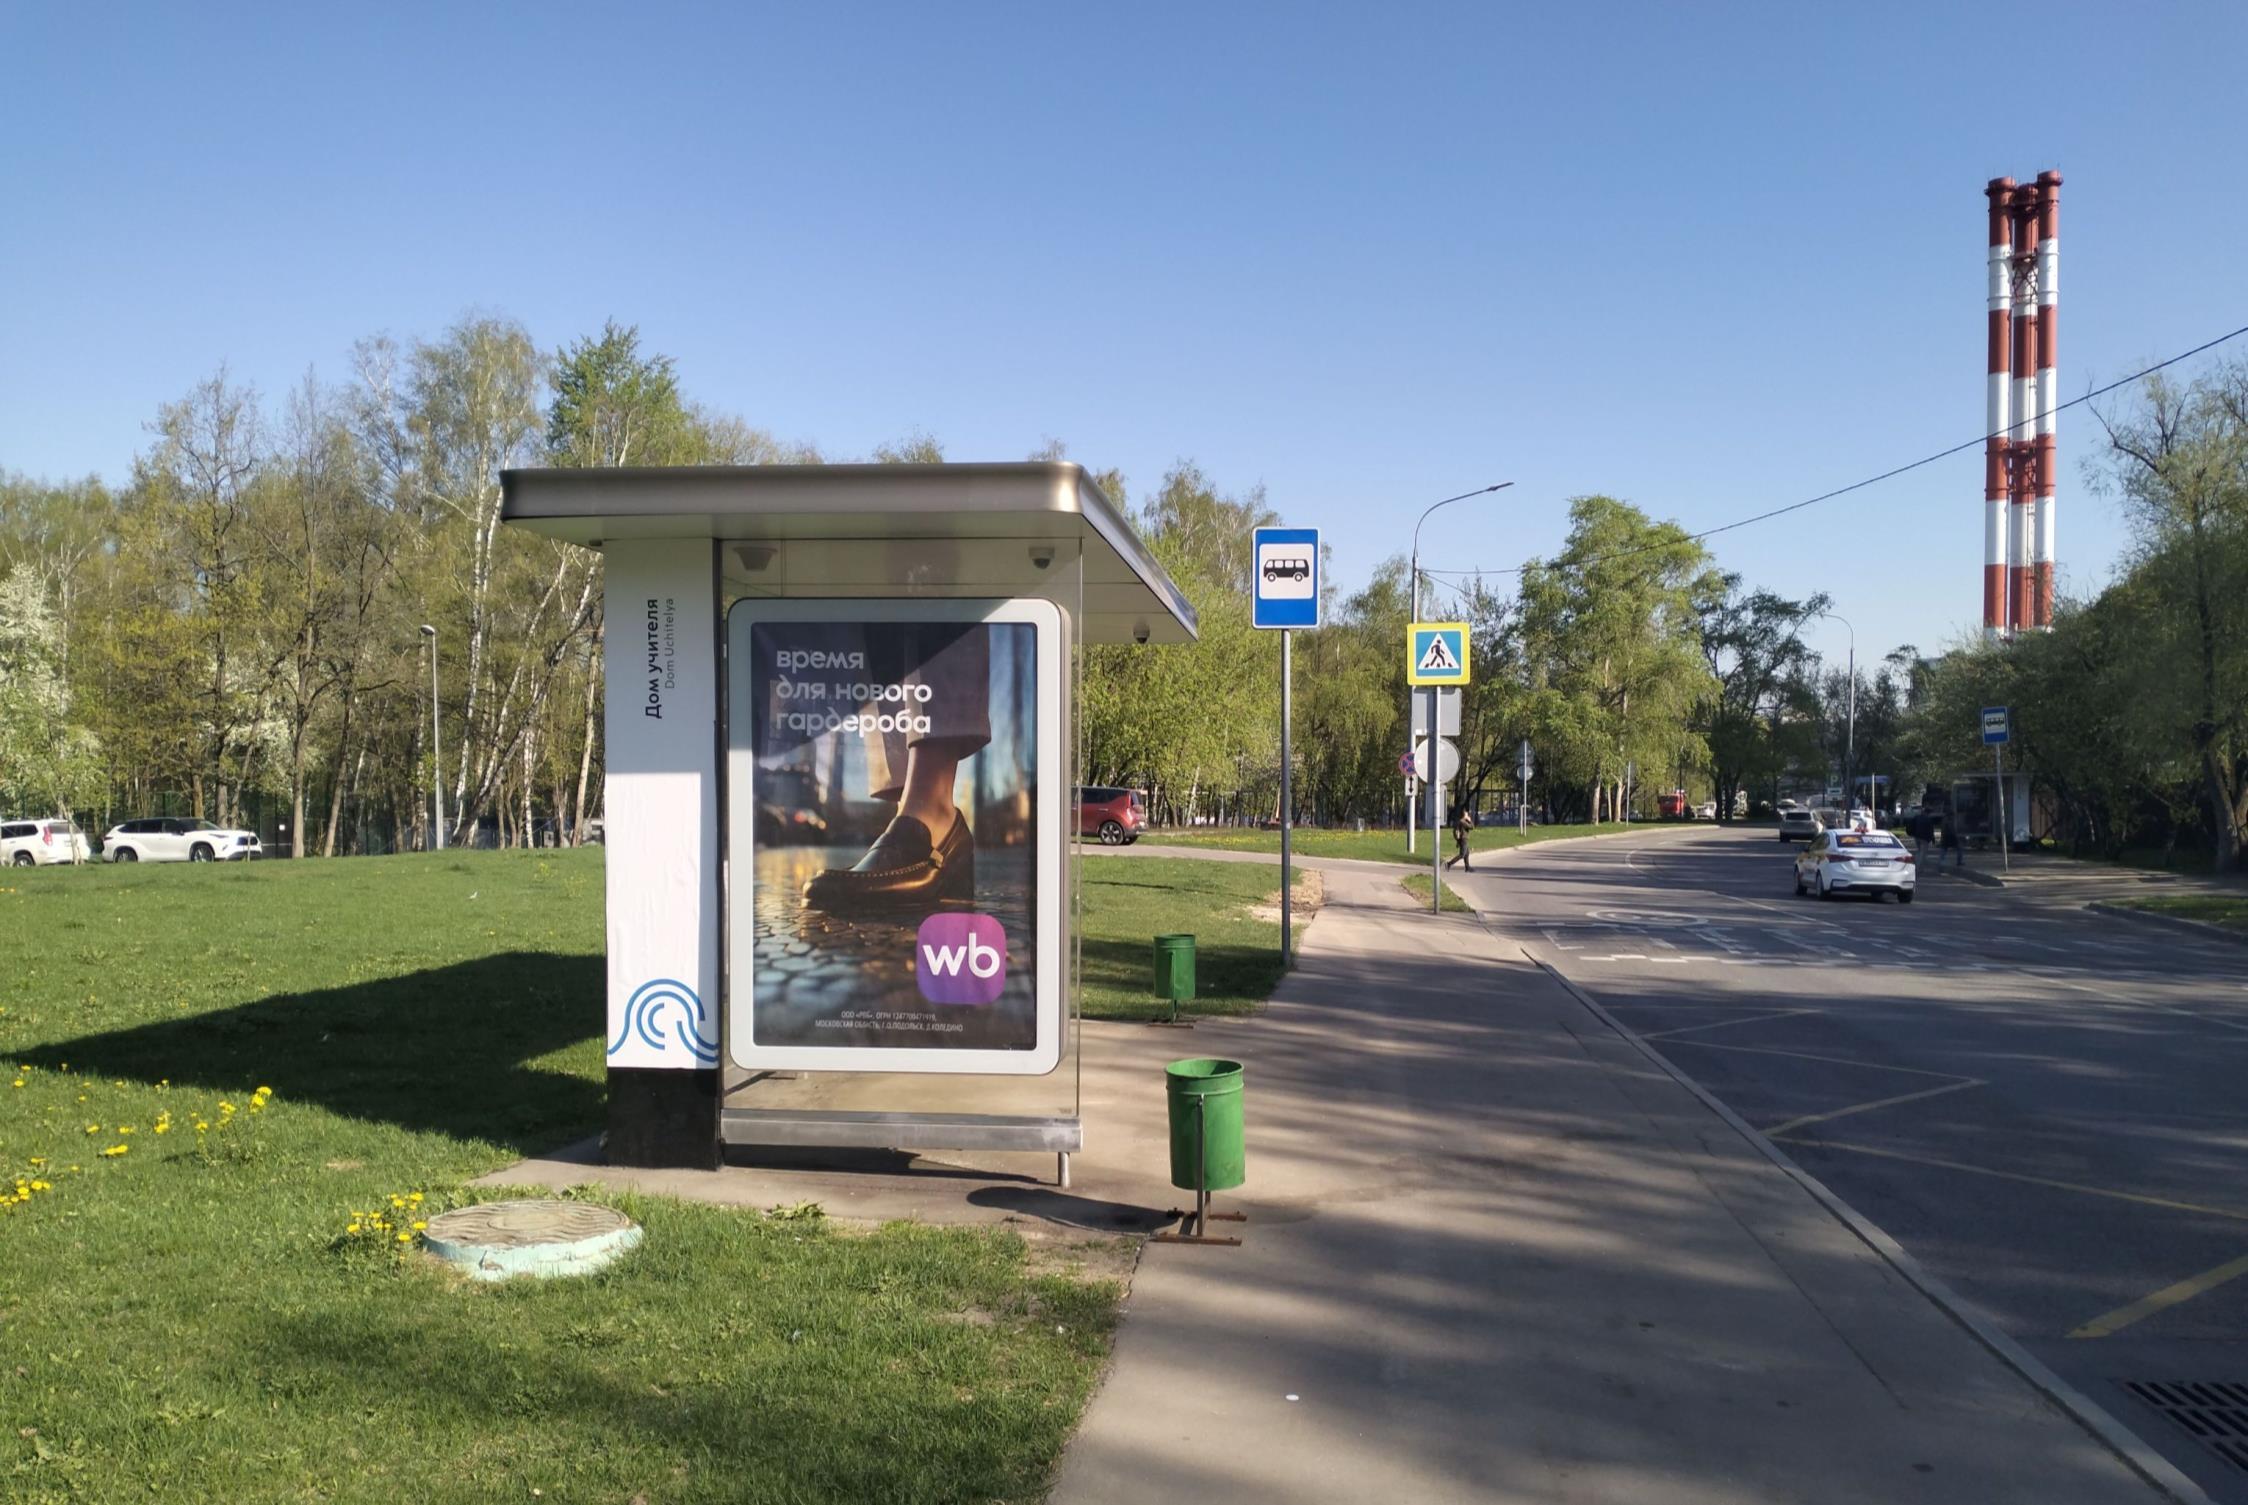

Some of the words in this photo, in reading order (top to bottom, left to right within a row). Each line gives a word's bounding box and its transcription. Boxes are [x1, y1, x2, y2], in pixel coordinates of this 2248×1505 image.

[647, 599, 662, 673] учителя
[663, 598, 676, 657] Uchitelya
[664, 660, 675, 689] Dom
[776, 650, 864, 674] время
[645, 678, 662, 719] Дом
[776, 674, 826, 700] для
[835, 683, 932, 703] нового
[776, 707, 932, 738] гардероба
[922, 932, 1001, 978] wb
